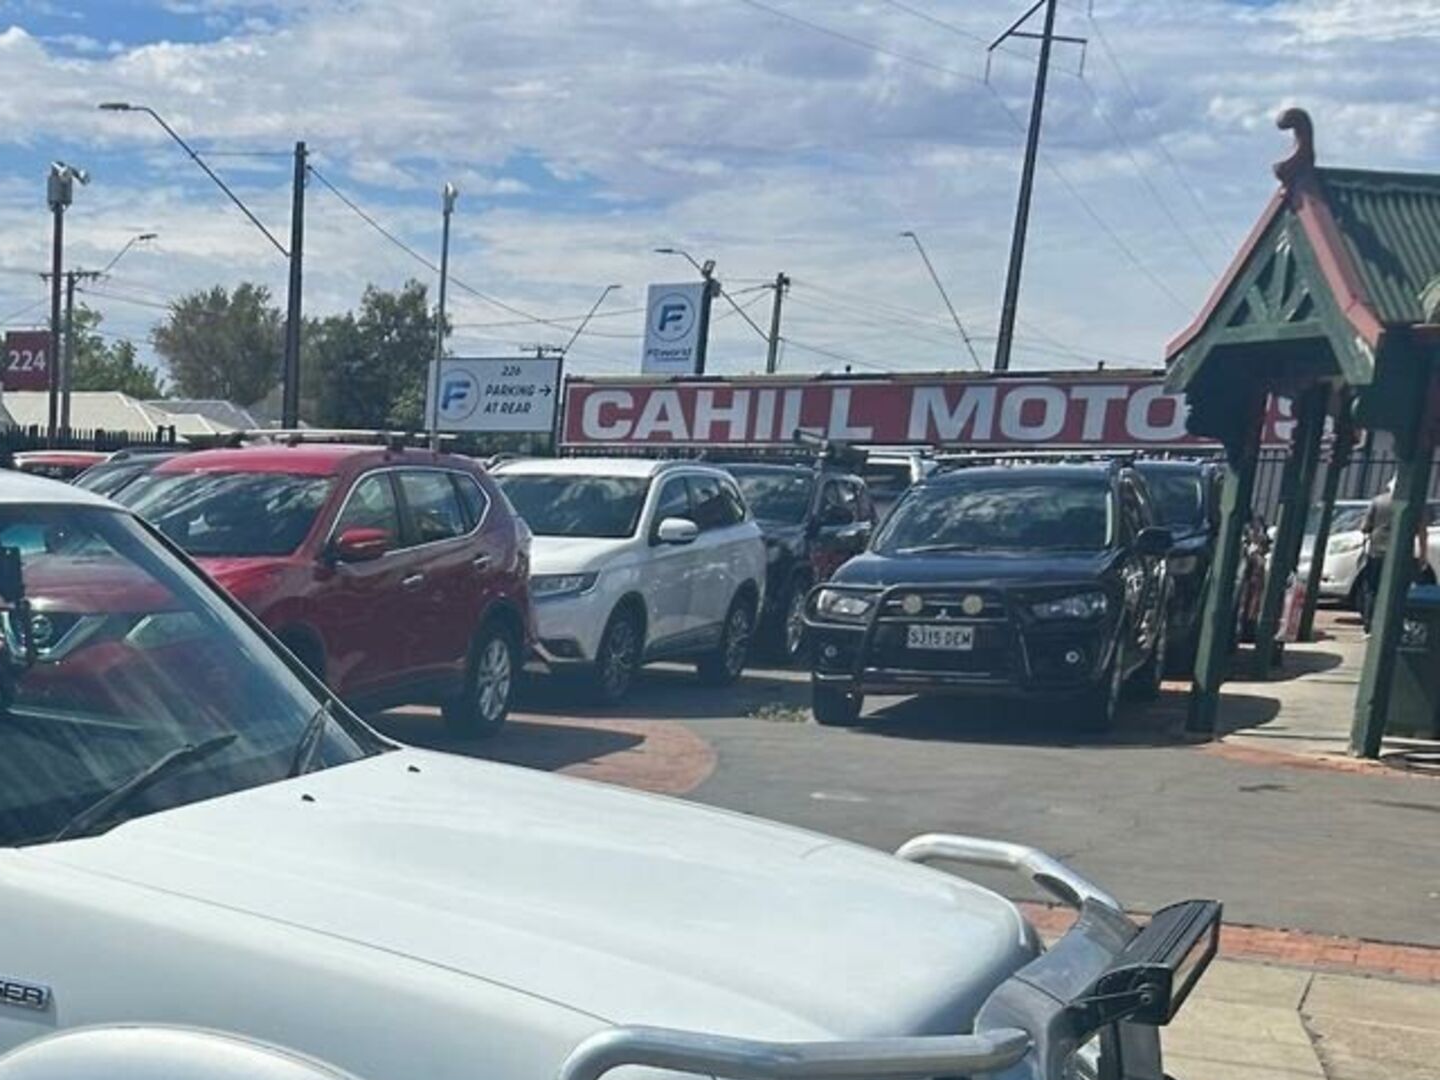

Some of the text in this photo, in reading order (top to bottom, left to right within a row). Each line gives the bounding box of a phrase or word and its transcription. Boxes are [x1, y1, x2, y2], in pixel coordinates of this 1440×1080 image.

[7, 349, 46, 371] 224
[485, 384, 536, 396] PARKING
[483, 402, 532, 414] AT REAR
[581, 387, 873, 441] CAHILL
